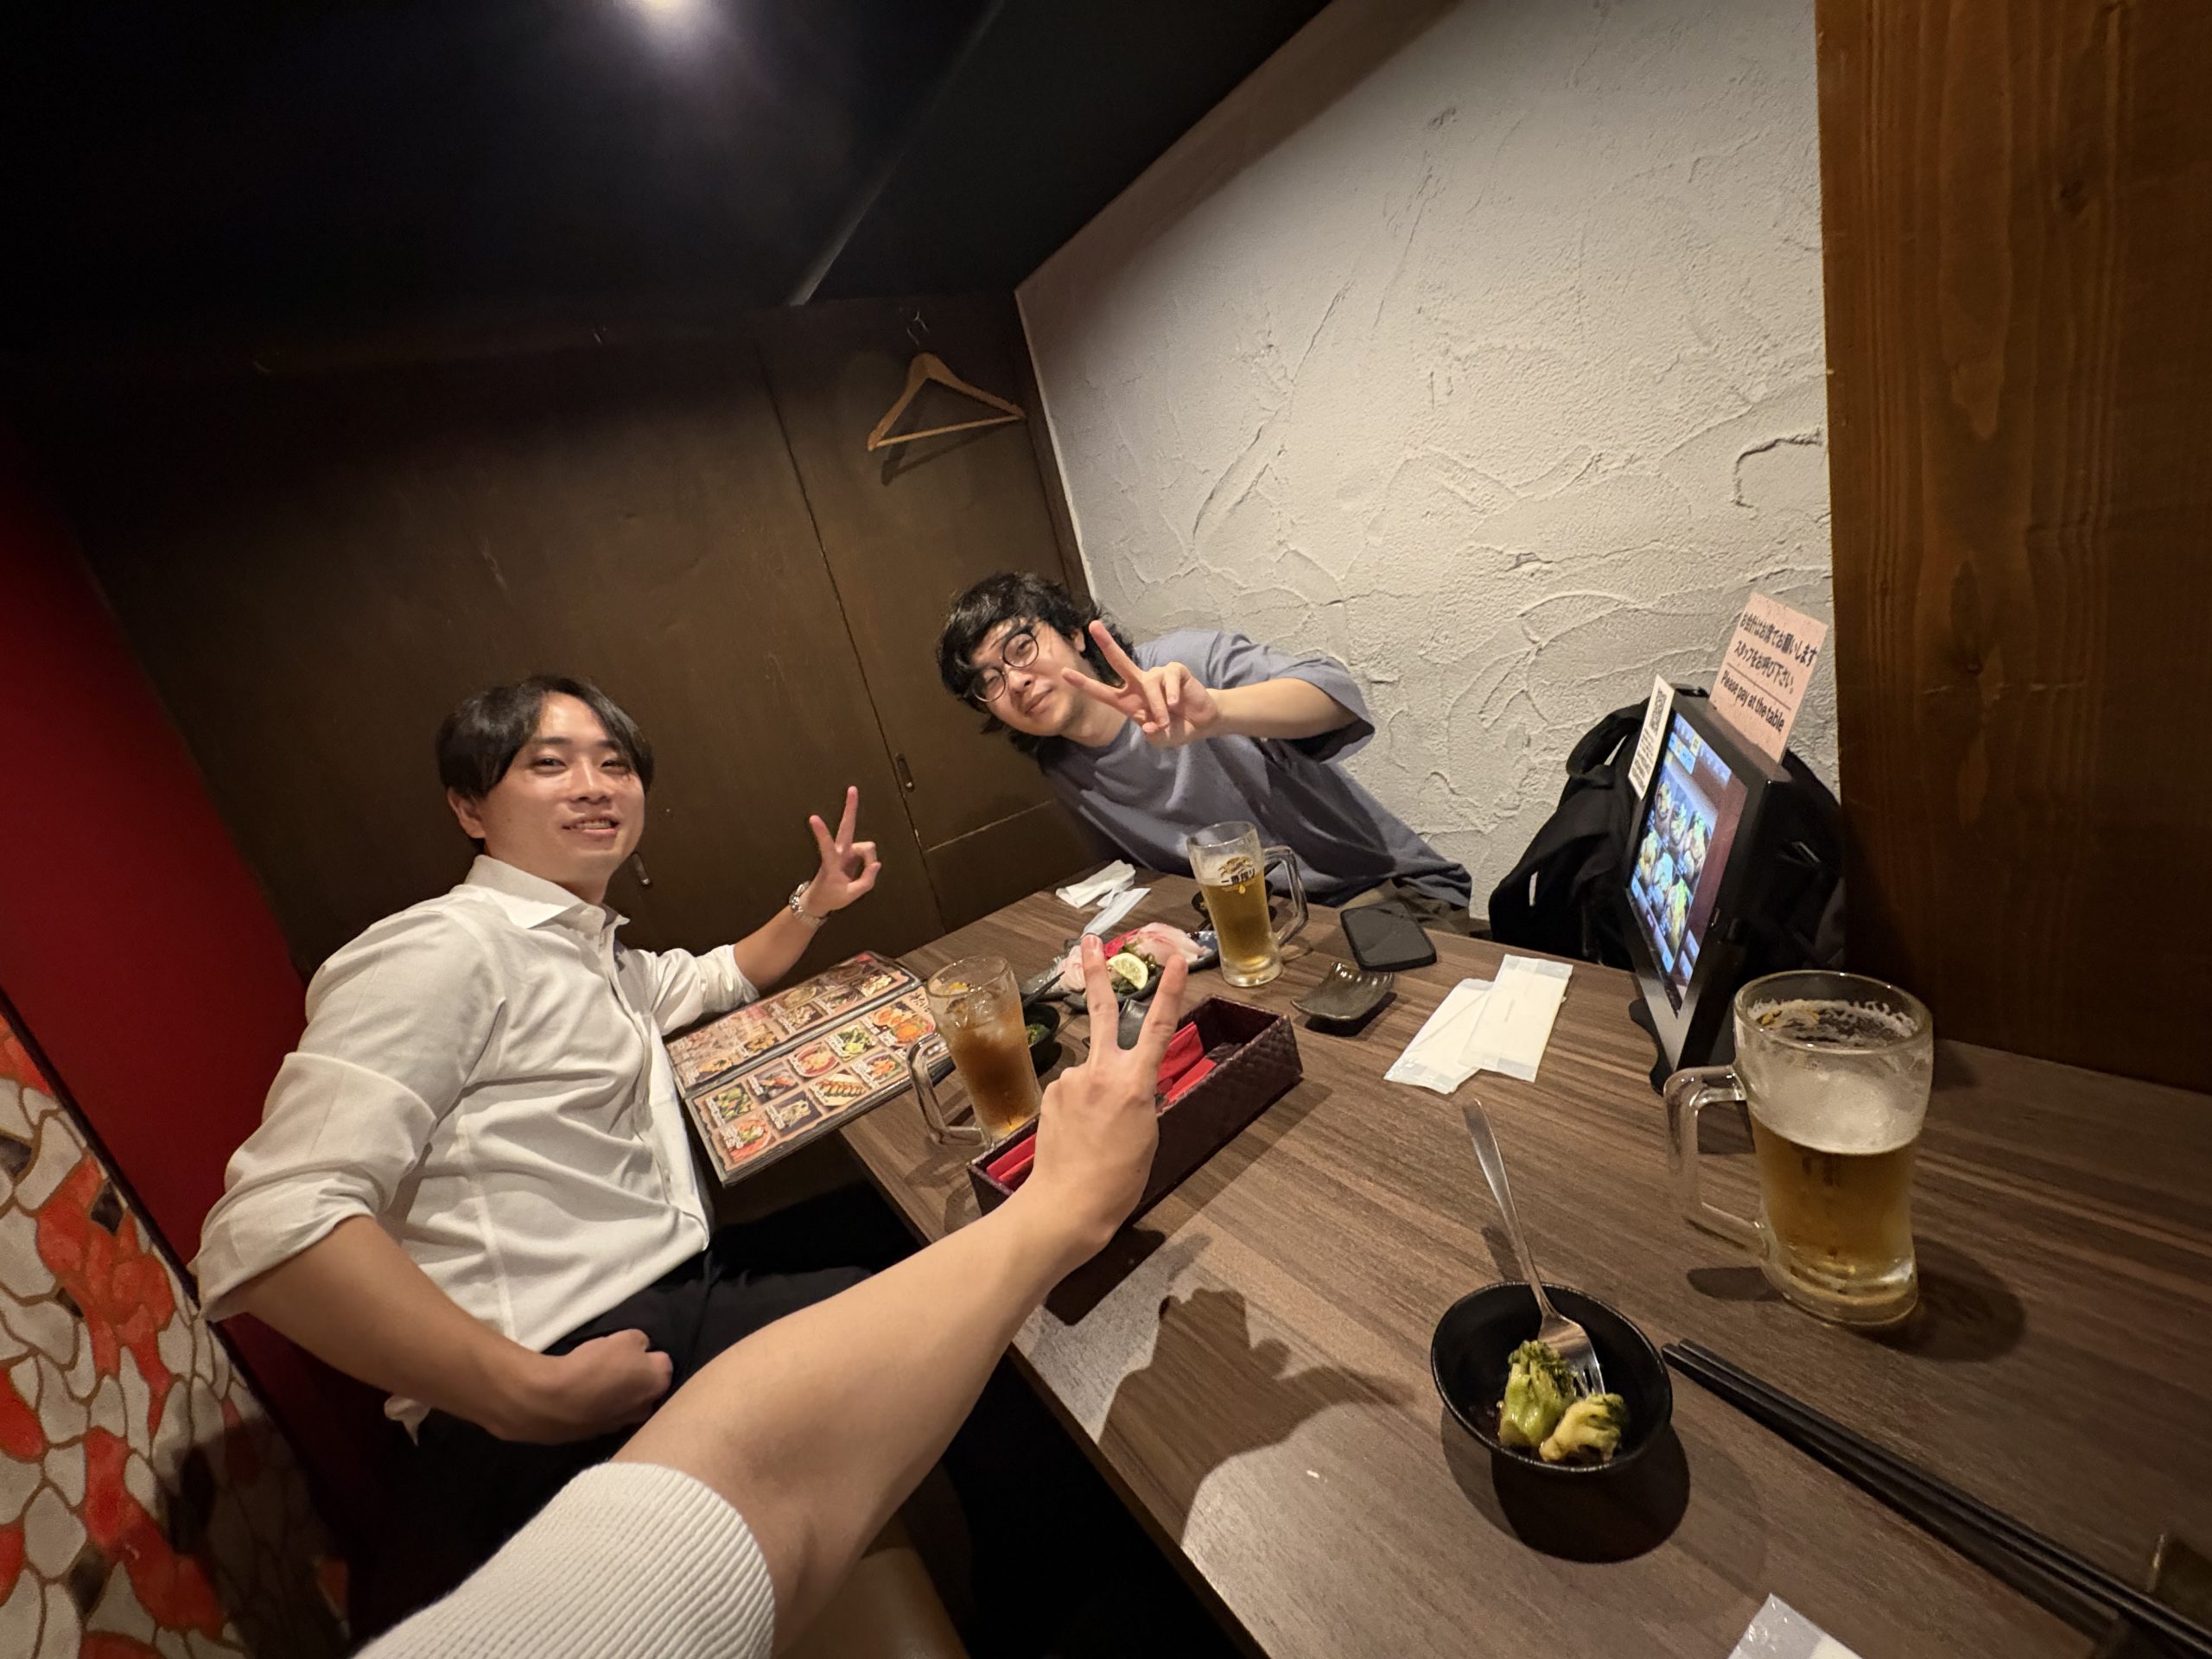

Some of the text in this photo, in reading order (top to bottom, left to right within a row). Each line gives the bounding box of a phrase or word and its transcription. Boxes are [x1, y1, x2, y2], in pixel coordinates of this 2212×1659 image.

[1720, 670, 1784, 733] Please pay at the table
